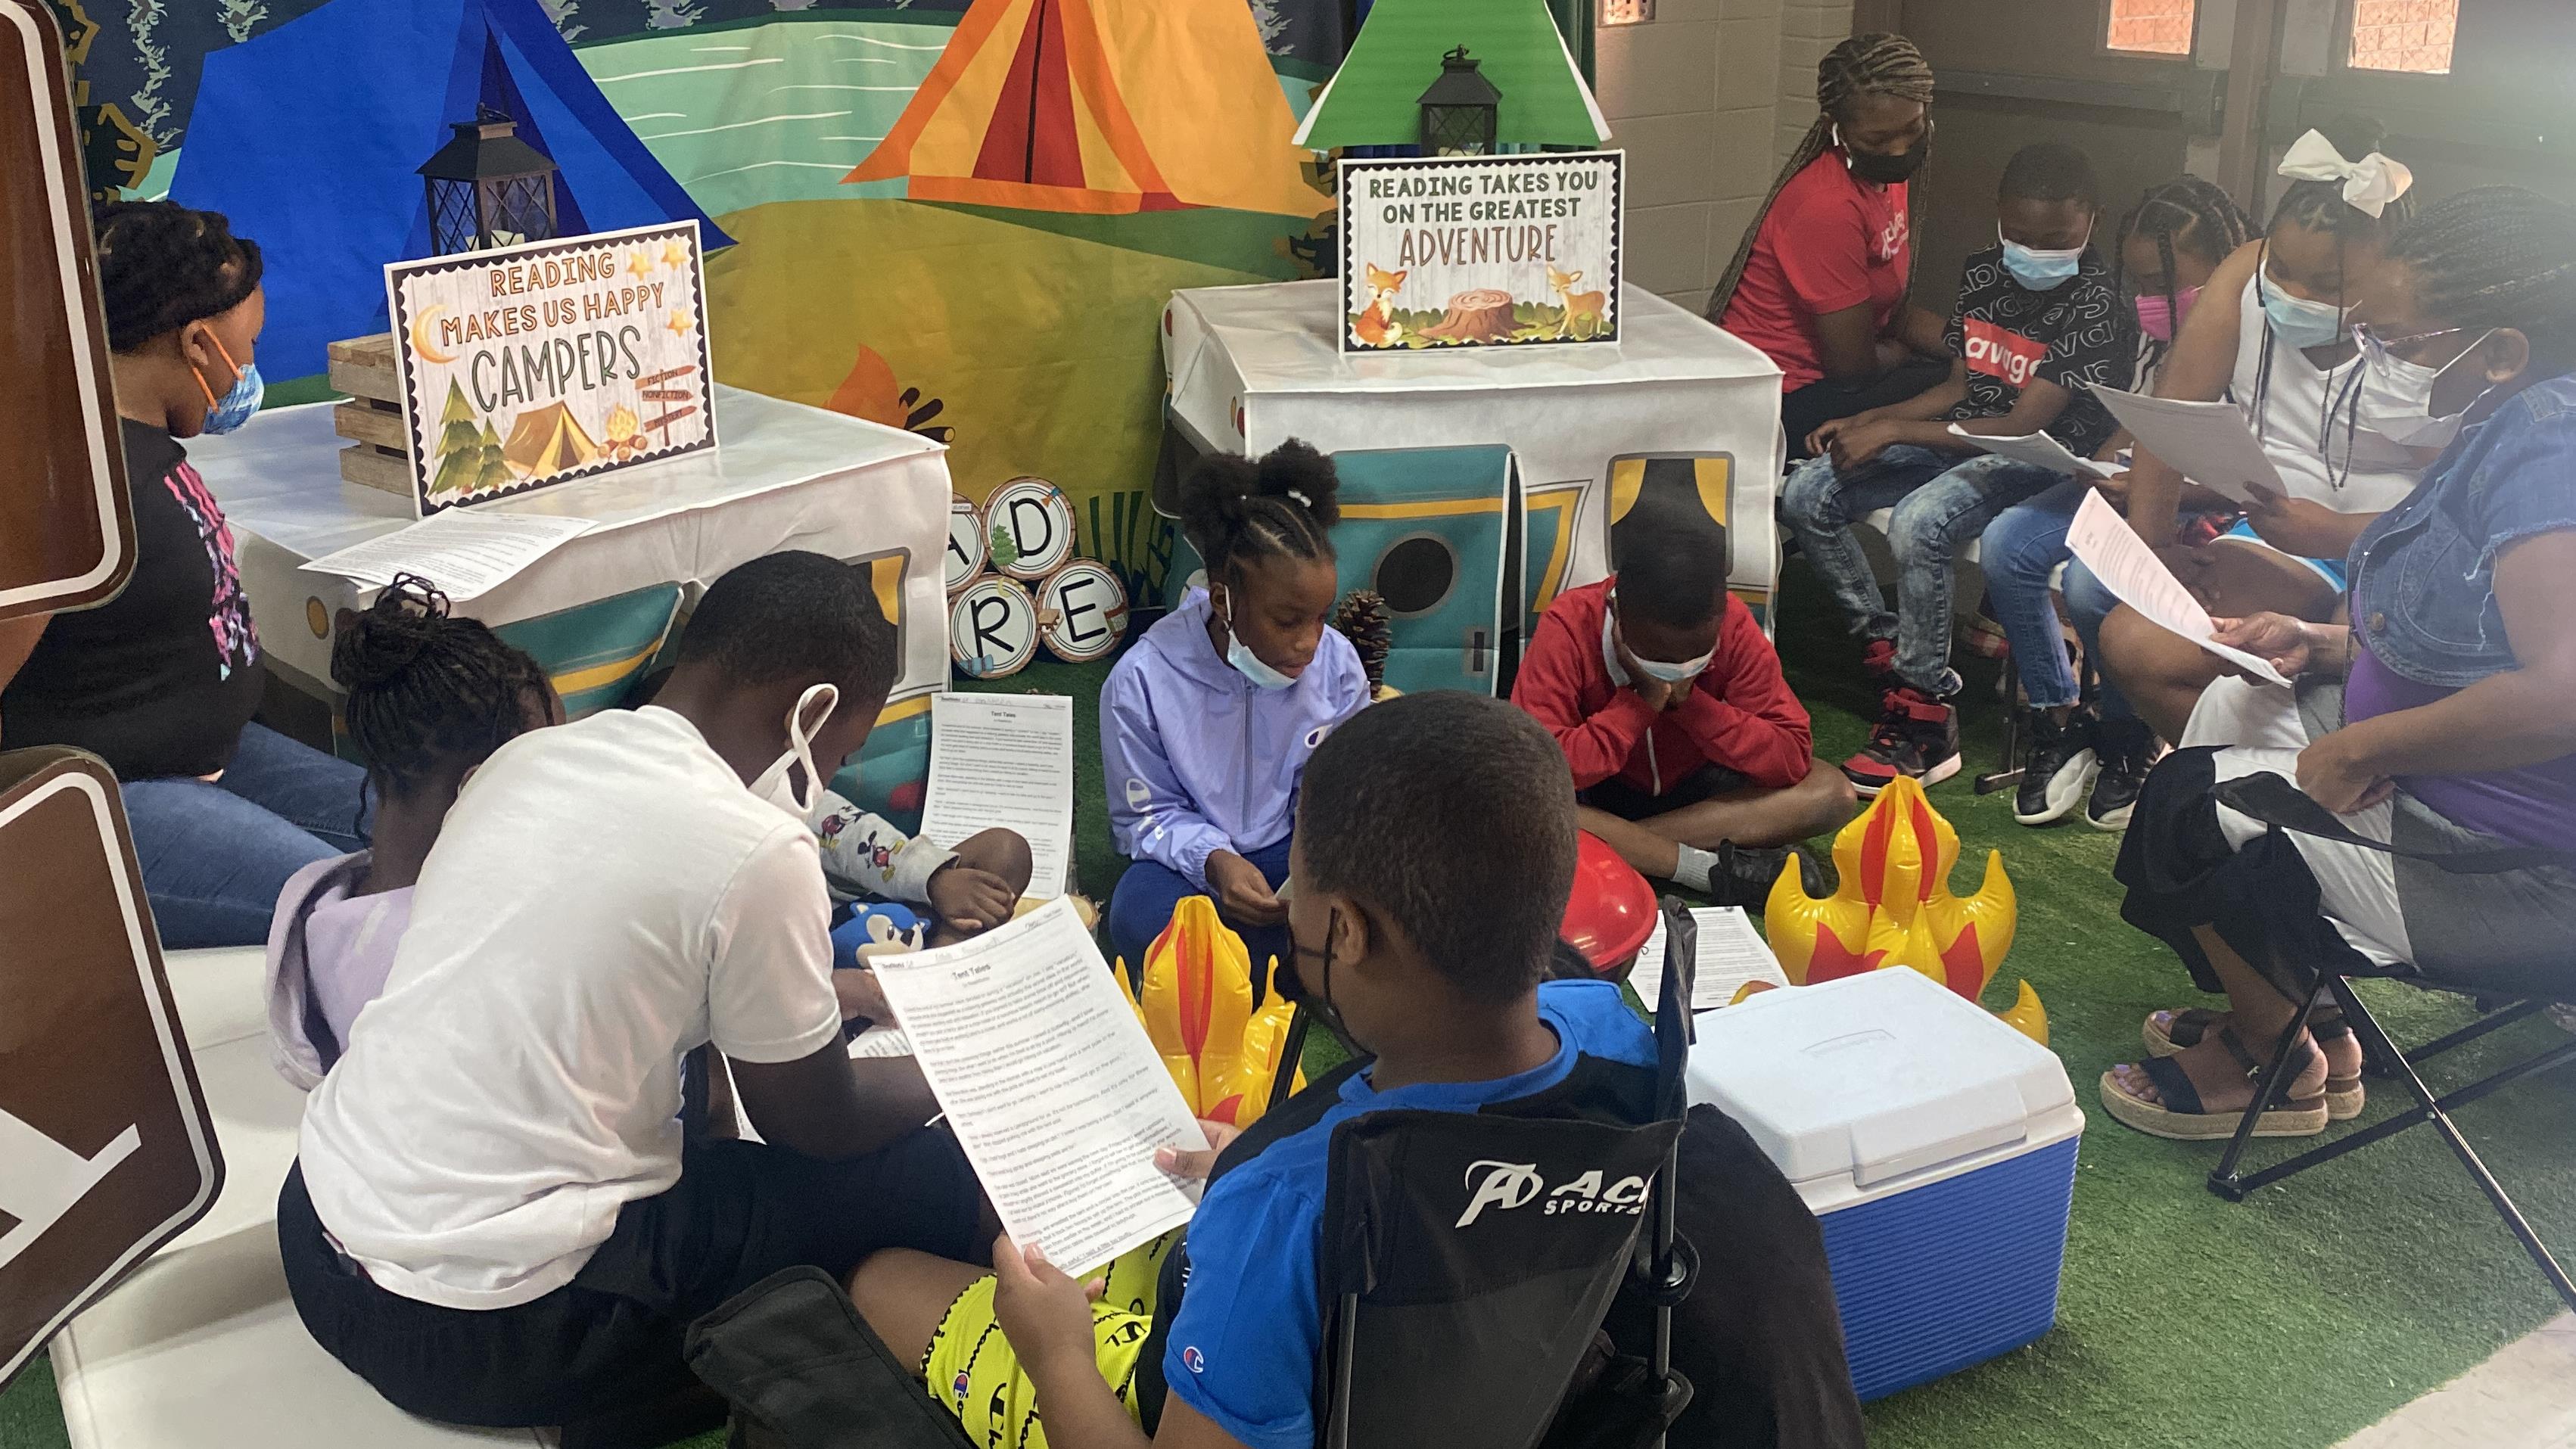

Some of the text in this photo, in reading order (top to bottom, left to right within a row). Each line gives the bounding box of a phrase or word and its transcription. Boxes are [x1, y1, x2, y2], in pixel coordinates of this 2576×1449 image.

[1370, 171, 1598, 198] READING TAKES YOU
[1383, 197, 1581, 224] ON THE GREATEST
[1400, 225, 1557, 266] ADVENTURE
[490, 253, 614, 297] READING
[440, 282, 664, 347] MAKES US HAPPY
[471, 325, 641, 412] CAMPERS
[648, 370, 678, 386] FICTION
[642, 390, 689, 400] NONFICTION
[1010, 498, 1052, 558] D
[970, 578, 1106, 658] R E
